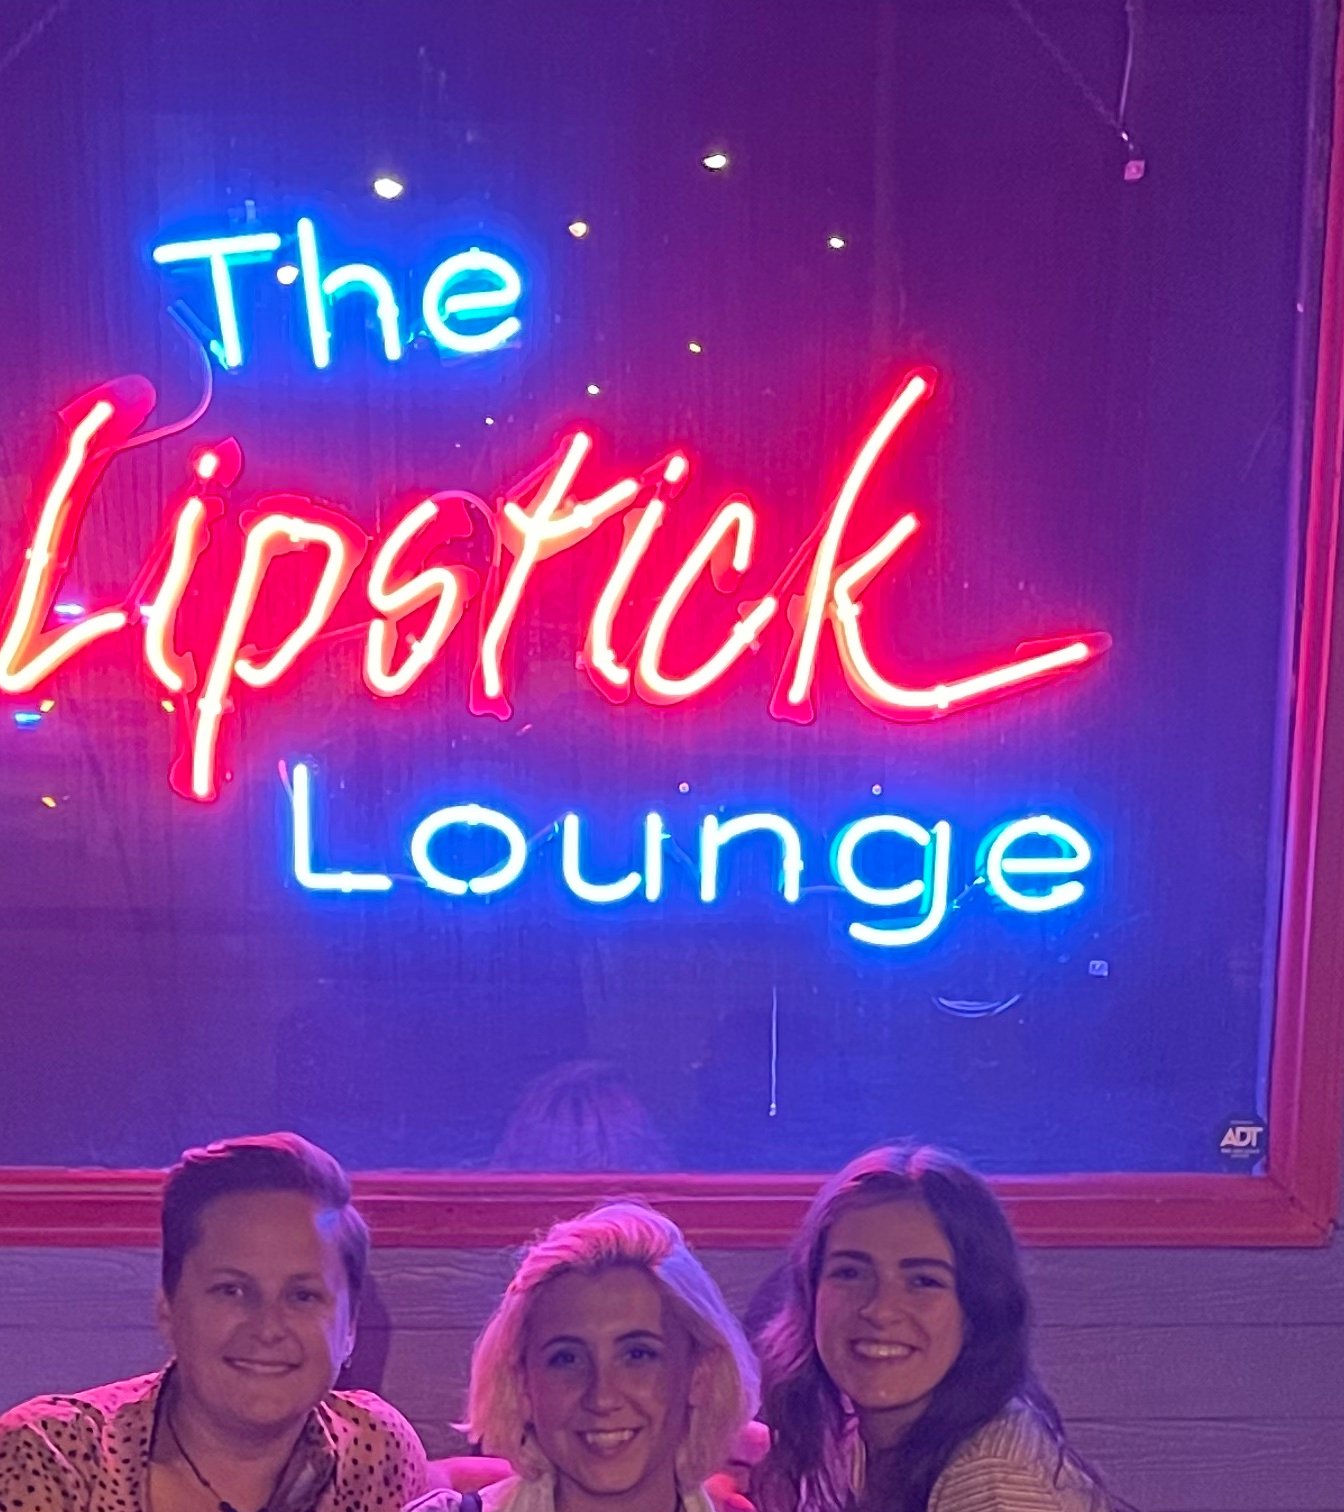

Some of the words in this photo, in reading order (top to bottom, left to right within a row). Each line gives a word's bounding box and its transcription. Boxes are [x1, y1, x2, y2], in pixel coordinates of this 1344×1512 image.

[153, 217, 522, 370] The
[292, 763, 1092, 948] Lounge
[1220, 1126, 1263, 1147] ADT
